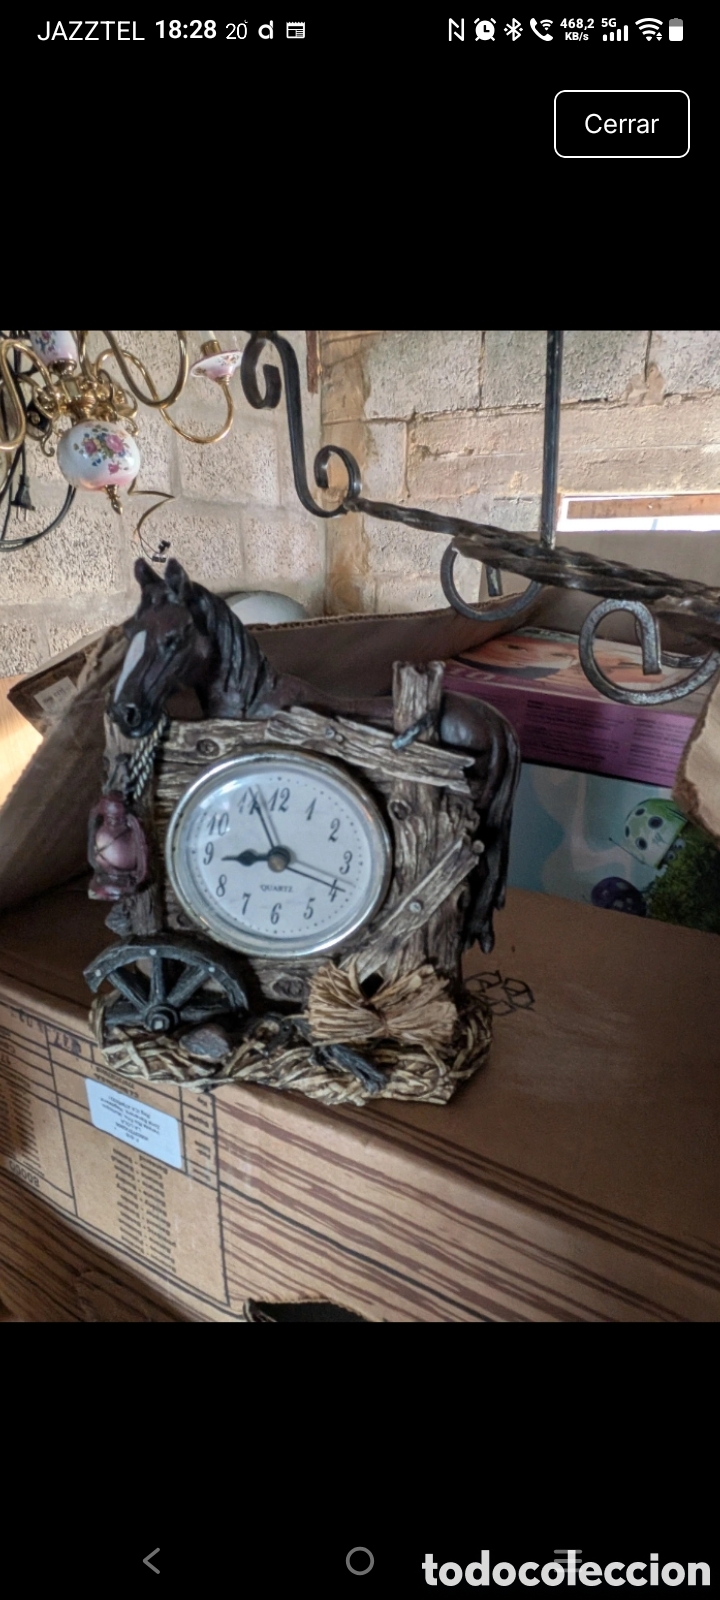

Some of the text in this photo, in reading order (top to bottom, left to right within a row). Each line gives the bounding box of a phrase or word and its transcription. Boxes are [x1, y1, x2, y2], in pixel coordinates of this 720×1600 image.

[37, 20, 145, 41] JAZZTEL
[155, 19, 217, 39] 18:28
[559, 18, 595, 30] 468,2
[601, 18, 617, 28] 5G
[564, 31, 589, 42] KB/s
[584, 113, 660, 134] Cerrar
[268, 787, 290, 813] 12
[306, 798, 317, 821] 1
[207, 812, 230, 836] 10
[328, 818, 341, 842] 2
[203, 841, 214, 865] 9
[339, 850, 353, 875] 3
[216, 874, 227, 897] 8
[260, 884, 294, 893] QUARTZ
[327, 878, 339, 902] 4
[241, 892, 251, 915] 7
[270, 902, 282, 925] 6
[303, 897, 316, 919] 5
